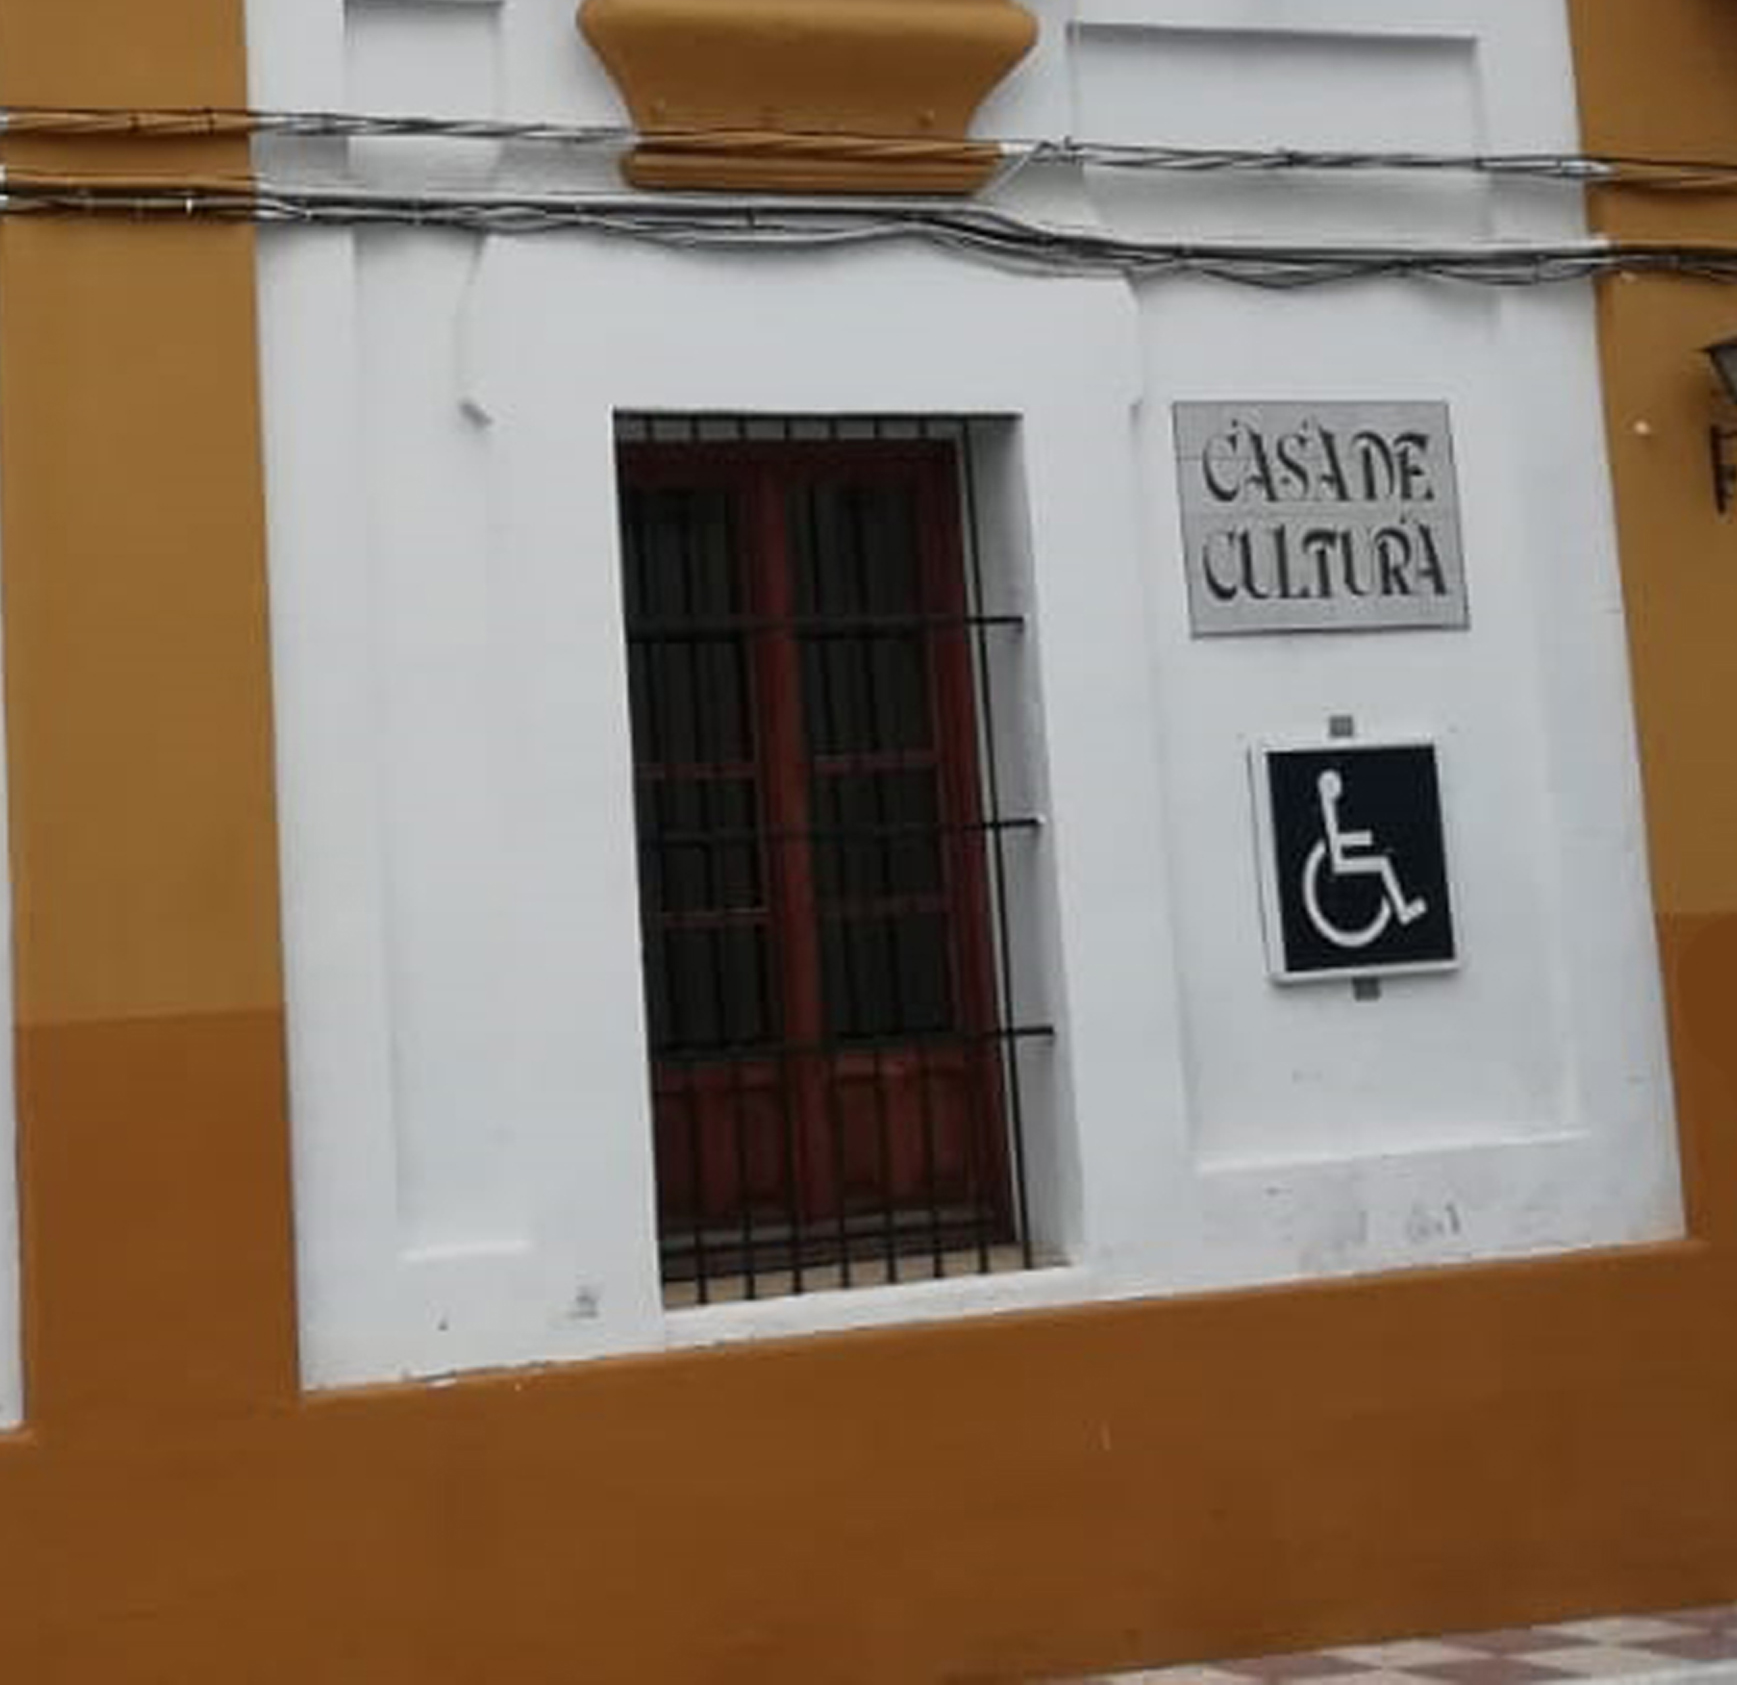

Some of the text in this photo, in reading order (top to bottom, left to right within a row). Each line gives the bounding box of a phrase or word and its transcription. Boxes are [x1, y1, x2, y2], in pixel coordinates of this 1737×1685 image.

[1202, 418, 1436, 503] CASA DE
[1202, 514, 1448, 601] CULTURA
